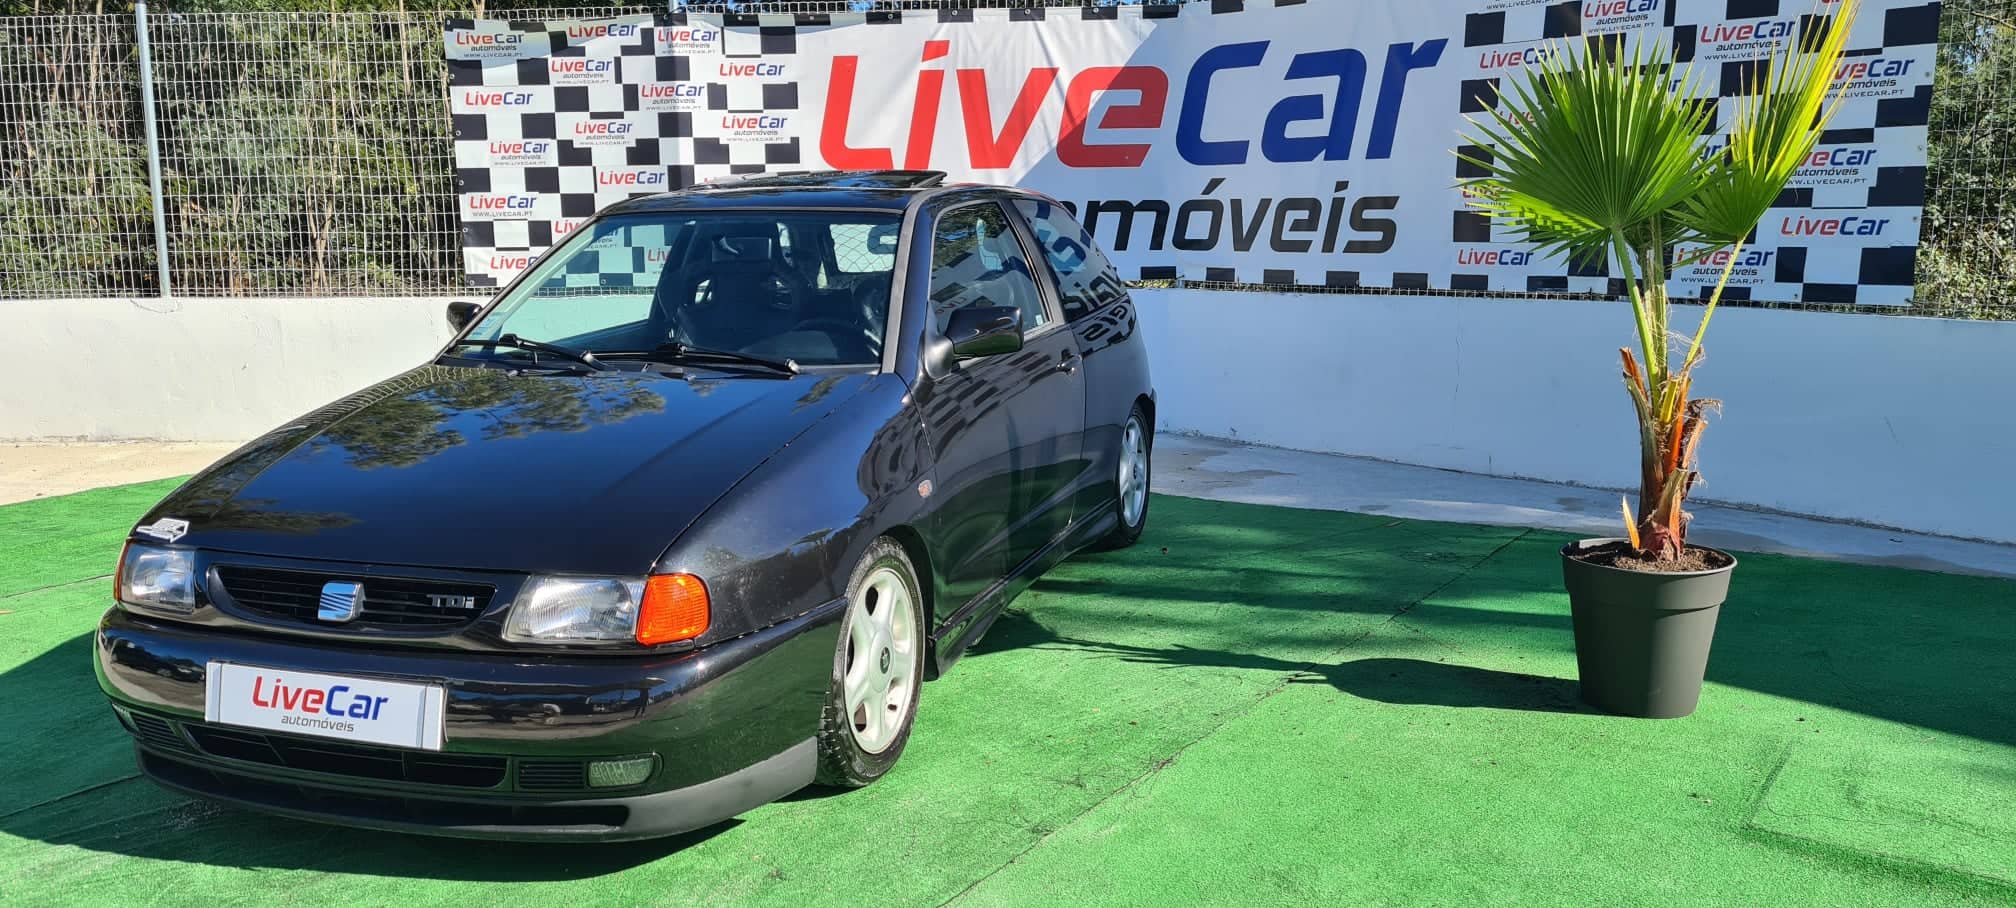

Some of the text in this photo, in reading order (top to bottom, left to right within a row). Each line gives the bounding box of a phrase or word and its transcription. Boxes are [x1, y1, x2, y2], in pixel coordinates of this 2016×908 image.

[1596, 14, 1649, 25] automóveis
[568, 23, 638, 38] LiveCar
[658, 29, 719, 43] LiveCar
[1701, 20, 1795, 43] LiveCar
[456, 32, 524, 45] LiveCar
[1716, 40, 1782, 52] automóves
[551, 59, 612, 72] LiveCar
[719, 62, 785, 76] LiveCar
[1834, 59, 1915, 80] veCar
[641, 84, 705, 98] LiveCar
[1825, 89, 1904, 98] WW.LIVECAR.PT
[465, 91, 534, 106] LiveCar
[819, 37, 1449, 170] LiveCar
[575, 121, 633, 134] LiveCar
[722, 115, 788, 129] LiveCar
[490, 141, 550, 154] LiveCar
[1800, 148, 1877, 167] veCar
[599, 171, 665, 185] LiveCar
[470, 195, 537, 209] LiveCar
[1058, 178, 1401, 254] móveis
[1781, 215, 1890, 236] LiveCar
[1458, 248, 1534, 266] LiveCar
[1692, 267, 1758, 276] autoveis
[1680, 277, 1764, 285] WWW.LICAR.PT
[252, 676, 389, 721] LiveCar
[281, 714, 354, 732] automóveis
